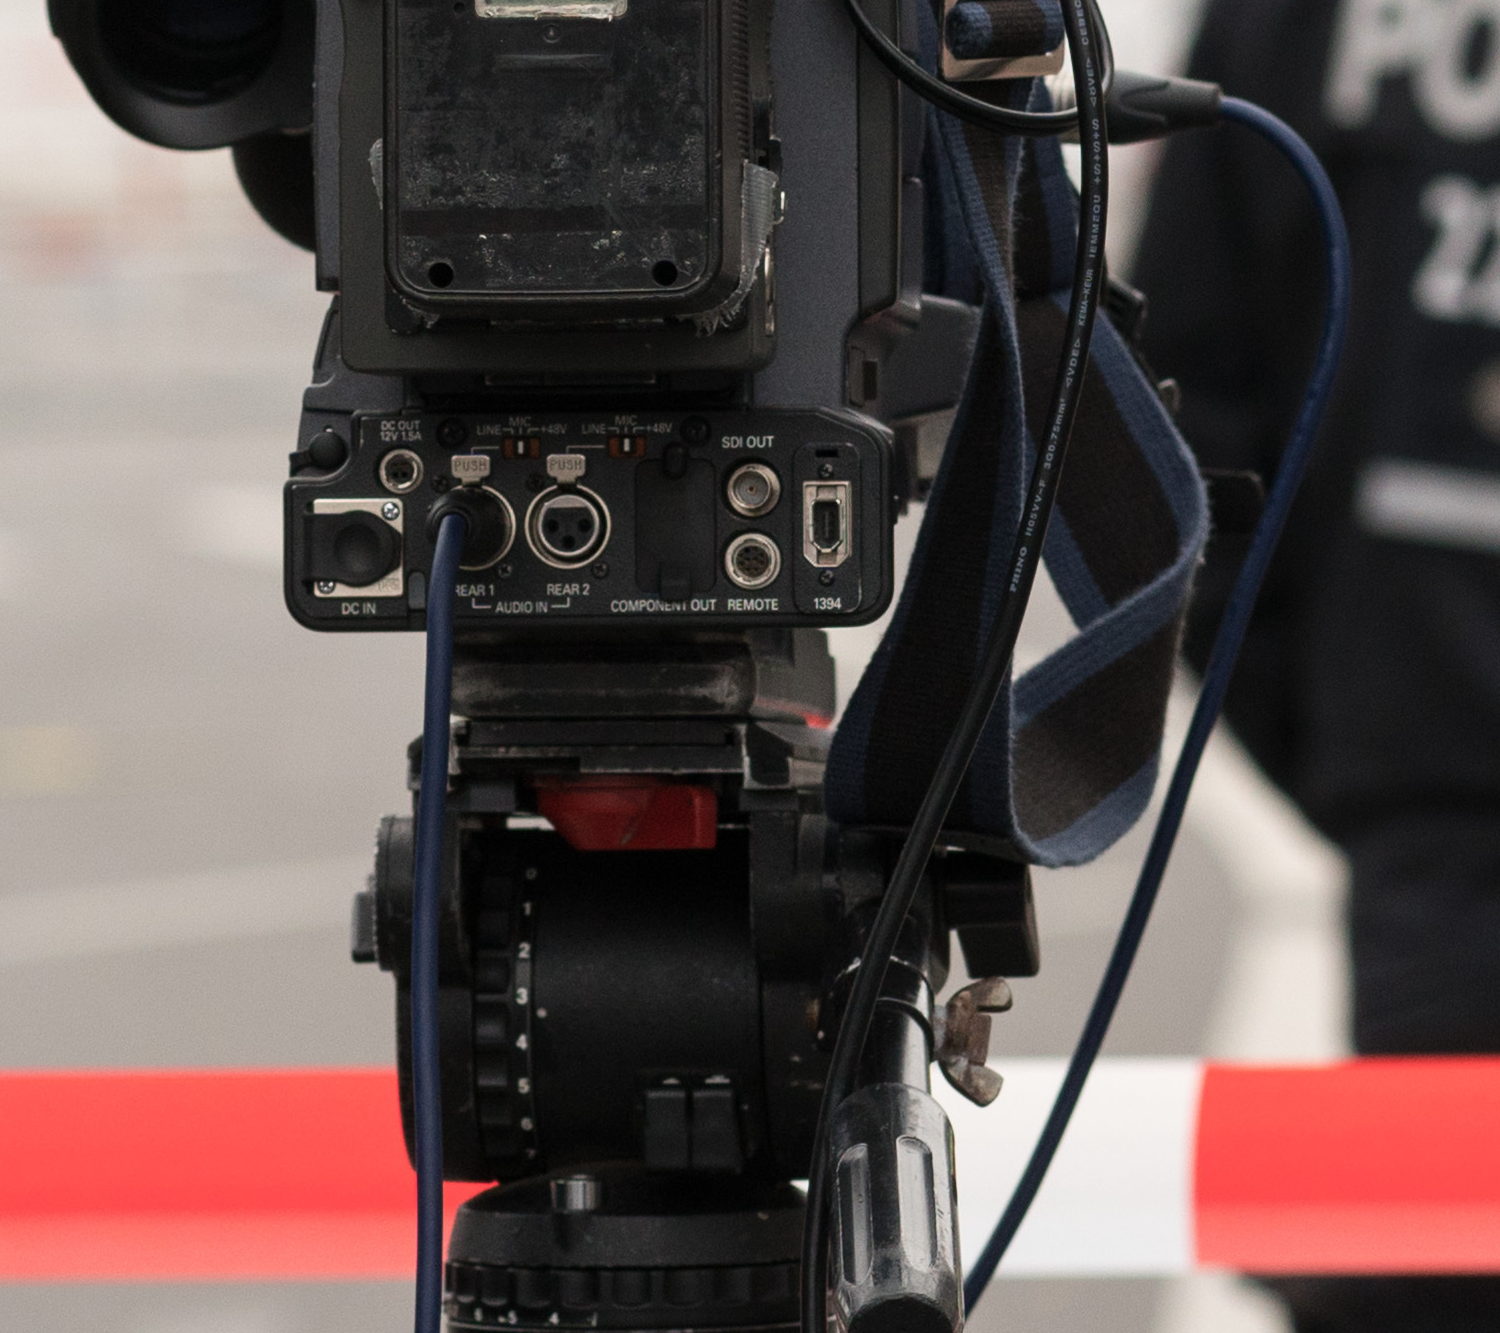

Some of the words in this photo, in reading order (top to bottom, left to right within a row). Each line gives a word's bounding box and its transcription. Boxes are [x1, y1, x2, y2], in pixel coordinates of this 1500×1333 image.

[1074, 0, 1089, 46] CEBEC
[1089, 194, 1101, 258] IEMMEQU
[1078, 269, 1094, 327] KEMA-KEUR
[381, 421, 397, 431] DC
[398, 420, 420, 431] OUT
[508, 416, 532, 427] MIC
[614, 415, 638, 426] MIC
[476, 425, 501, 435] LINE
[541, 423, 567, 434] +48V
[581, 424, 606, 434] LINE
[647, 422, 672, 433] +48V
[381, 432, 397, 441] 12V
[401, 431, 422, 441] 1.5A
[721, 436, 743, 449] SDI
[747, 435, 775, 448] OUT
[454, 459, 487, 471] PUSH
[549, 458, 582, 471] PUSH
[1025, 479, 1046, 536] H05VV-F
[488, 584, 495, 596] 1
[547, 584, 579, 596] REAR
[581, 584, 590, 596] 2
[341, 603, 360, 615] DC
[362, 602, 376, 614] IN
[495, 601, 533, 614] AUDIO
[535, 601, 548, 613] IN
[610, 599, 687, 613] COMPONENT
[690, 599, 717, 612] OUT
[727, 598, 780, 611] REMOTE
[813, 597, 842, 610] 1394
[523, 901, 532, 915] 1
[518, 942, 531, 958] 2
[515, 987, 528, 1005] 3
[515, 1034, 528, 1051] 4
[518, 1077, 530, 1094] 5
[521, 1117, 533, 1131] 6
